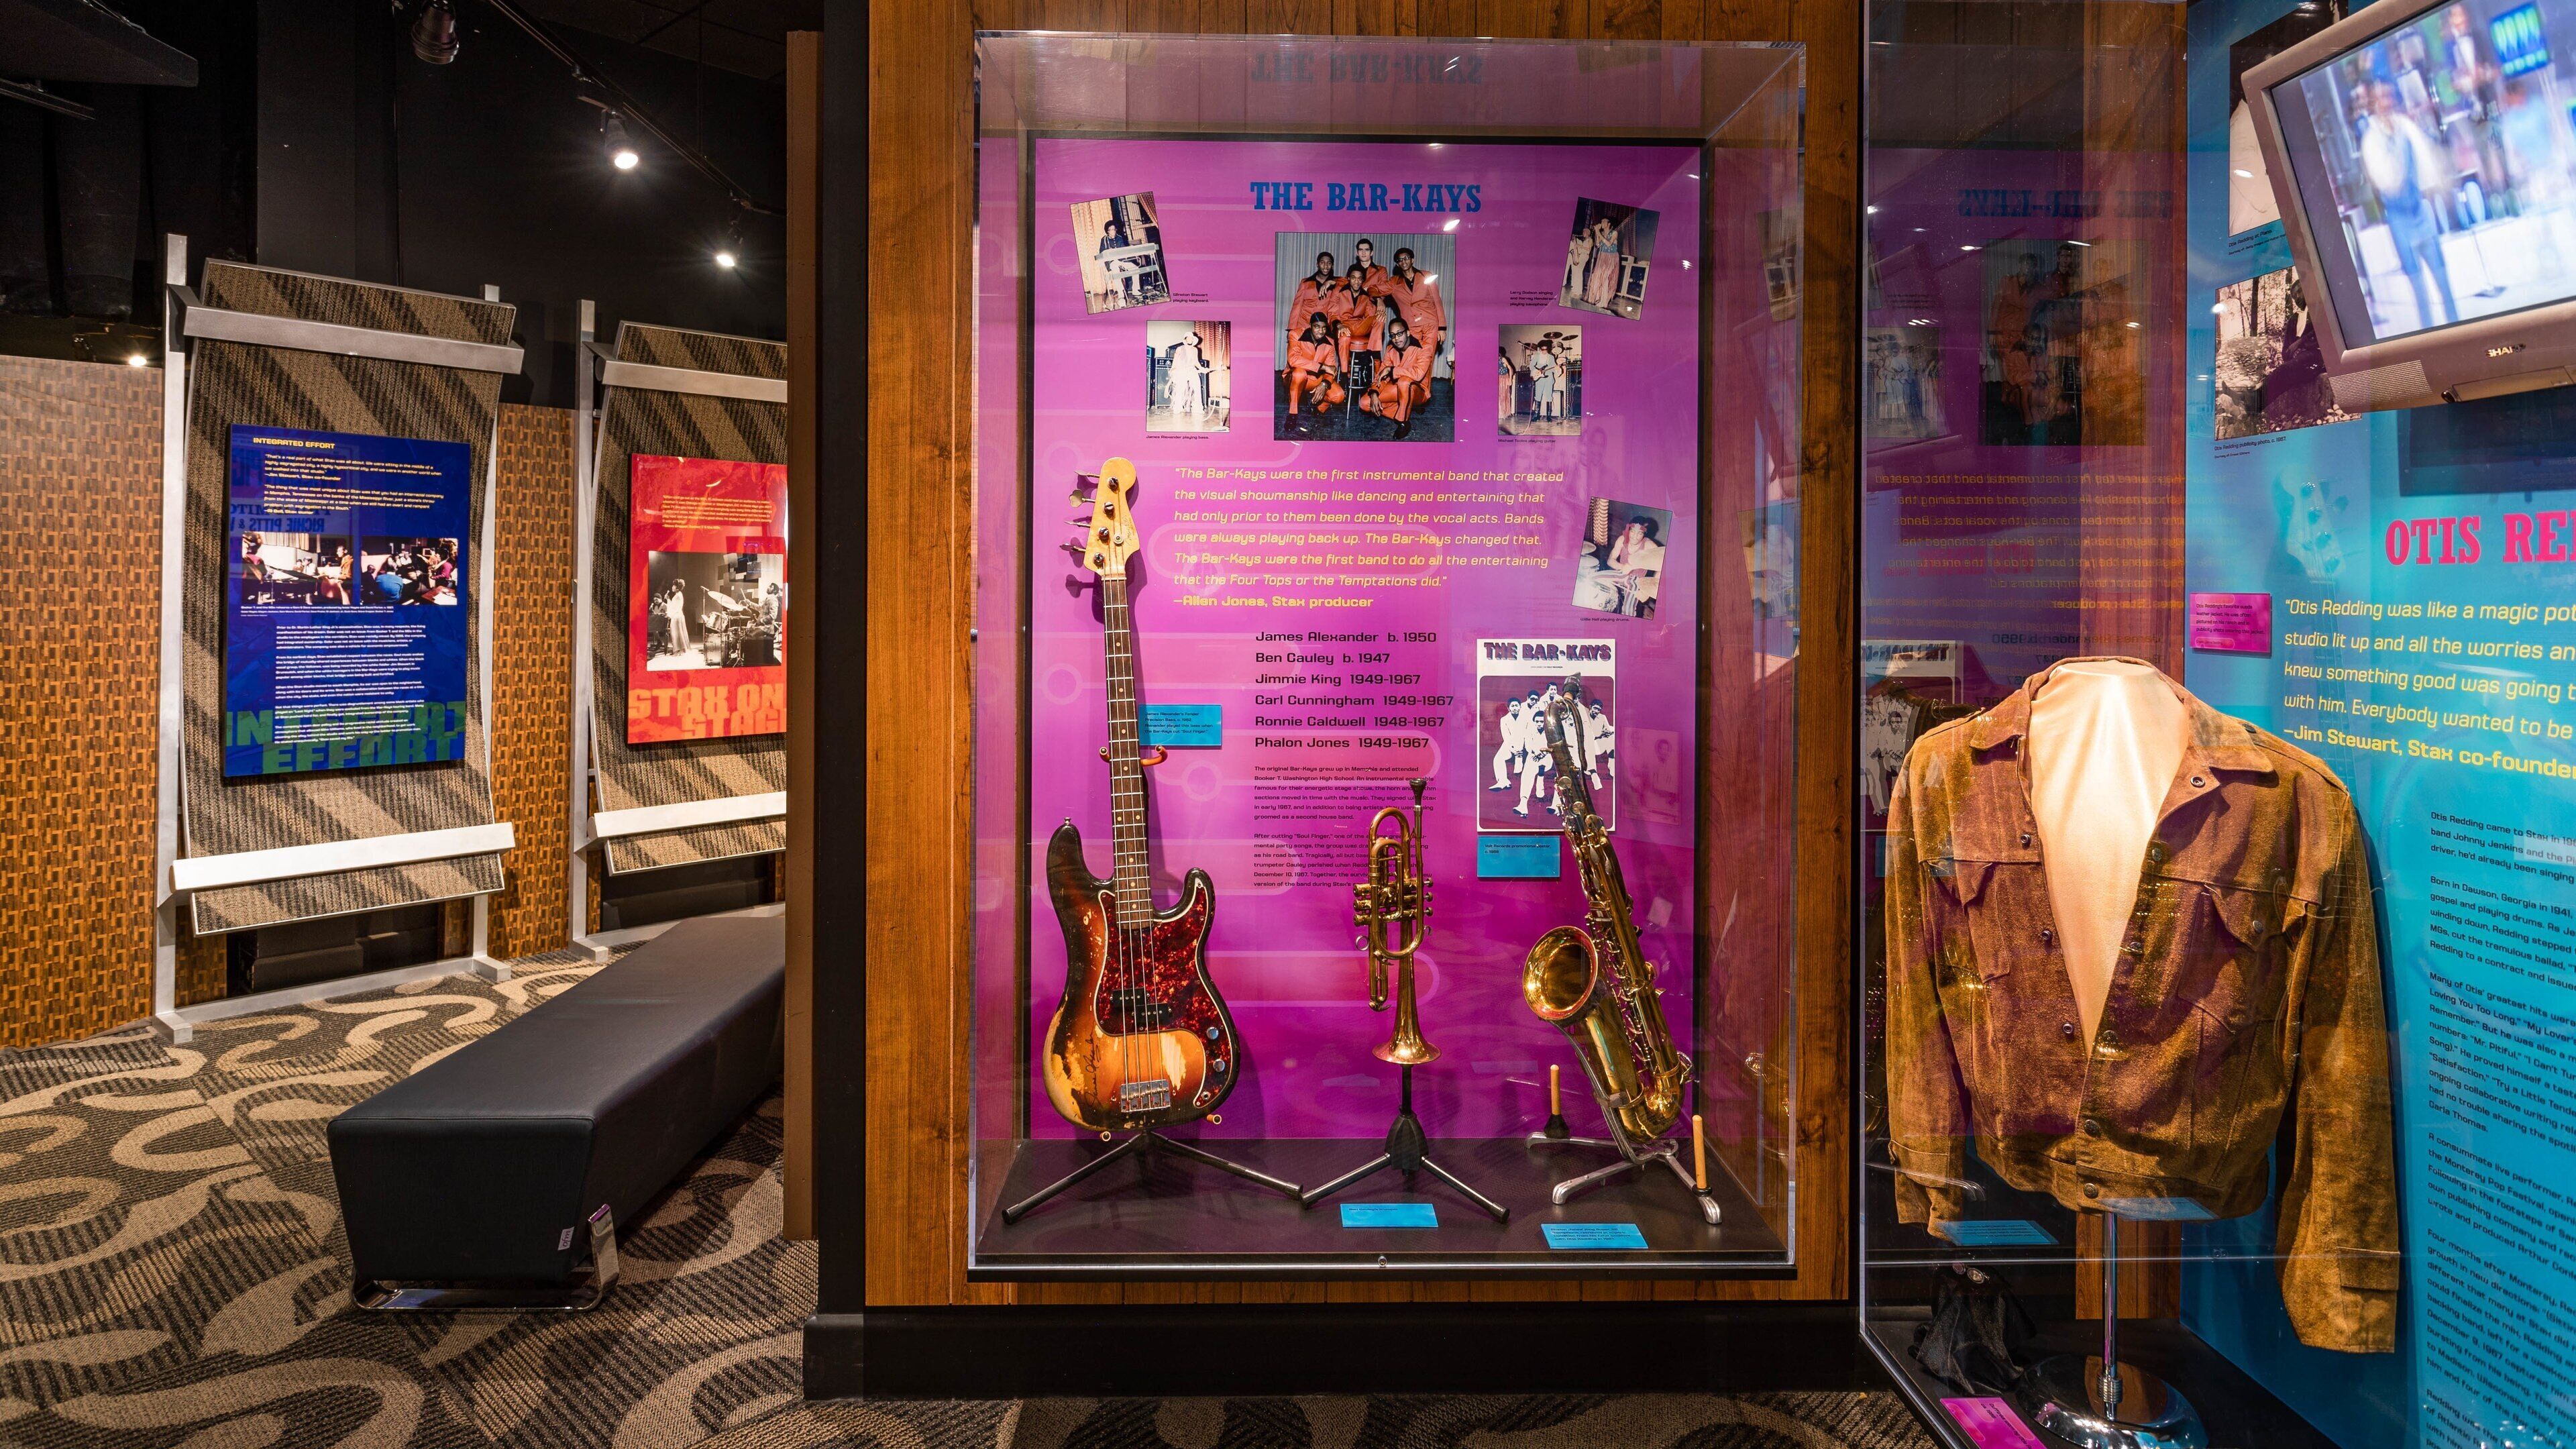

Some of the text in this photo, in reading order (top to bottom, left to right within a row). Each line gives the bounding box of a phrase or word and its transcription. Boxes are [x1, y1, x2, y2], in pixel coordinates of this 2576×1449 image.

[1250, 182, 1481, 213] THE BAR-KAYS
[254, 437, 335, 449] INTEGRATED EFFORT
[1207, 468, 1266, 482] Bar-Kays
[1271, 471, 1303, 480] were
[1307, 470, 1328, 480] the
[1332, 469, 1358, 482] first
[1363, 470, 1444, 480] instrumental
[1448, 470, 1479, 480] band
[1484, 471, 1509, 482] that
[1514, 472, 1563, 482] created
[1175, 489, 1545, 504] the visual showmanship like dancing and entertaining that
[1175, 511, 1544, 527] had only prior to them been done by the vocal acts. Bands
[1175, 532, 1541, 547] were always playing back up. The Bar-Kays changed that.
[2385, 510, 2576, 566] OTIS RE
[1175, 553, 1548, 569] The Bar-Kays were the first band to do all the entertaining
[1174, 574, 1201, 585] that
[1205, 574, 1226, 585] the
[1230, 574, 1259, 585] Four
[1263, 574, 1292, 588] Tops
[1296, 577, 1310, 586] or
[1313, 574, 1334, 585] the
[1339, 574, 1417, 588] Temptations
[1222, 595, 1267, 608] Jones,
[1273, 596, 1305, 606] Stax
[1309, 596, 1373, 609] producer
[2322, 599, 2383, 621] Redding
[2387, 604, 2422, 618] was
[2427, 601, 2457, 619] like
[2463, 605, 2474, 619] a
[2479, 603, 2538, 625] magic
[1256, 632, 1436, 642] James Alexander b. 1950
[2285, 631, 2328, 647] studio
[2332, 632, 2347, 649] lit
[2351, 637, 2369, 653] up
[2374, 635, 2404, 651] and
[2408, 635, 2428, 653] all
[2433, 637, 2463, 655] the
[2468, 641, 2542, 659] worries
[1256, 653, 1389, 665] Ben Cauley b. 1947
[1484, 642, 1611, 661] THE BAR-KAYS
[1256, 674, 1420, 687] Jimmie King 1949-1967
[2285, 661, 2322, 679] knew
[2326, 667, 2408, 690] something
[2413, 674, 2456, 692] good
[2461, 679, 2500, 694] was
[2506, 680, 2561, 704] going
[629, 683, 785, 719] STAX ON
[1256, 695, 1454, 708] Carl Cunningham 1949-1967
[682, 708, 786, 739] STAG
[1256, 716, 1444, 727] Ronnie Caldwell 1948-1967
[2284, 694, 2573, 740] with him. Everybody wanted to be
[1256, 737, 1429, 748] Phalon Jones 1949-1967
[2327, 729, 2402, 756] Stewart,
[2408, 739, 2453, 761] Stax
[2430, 875, 2572, 919] Born in Dawson, Georgia in 1941,
